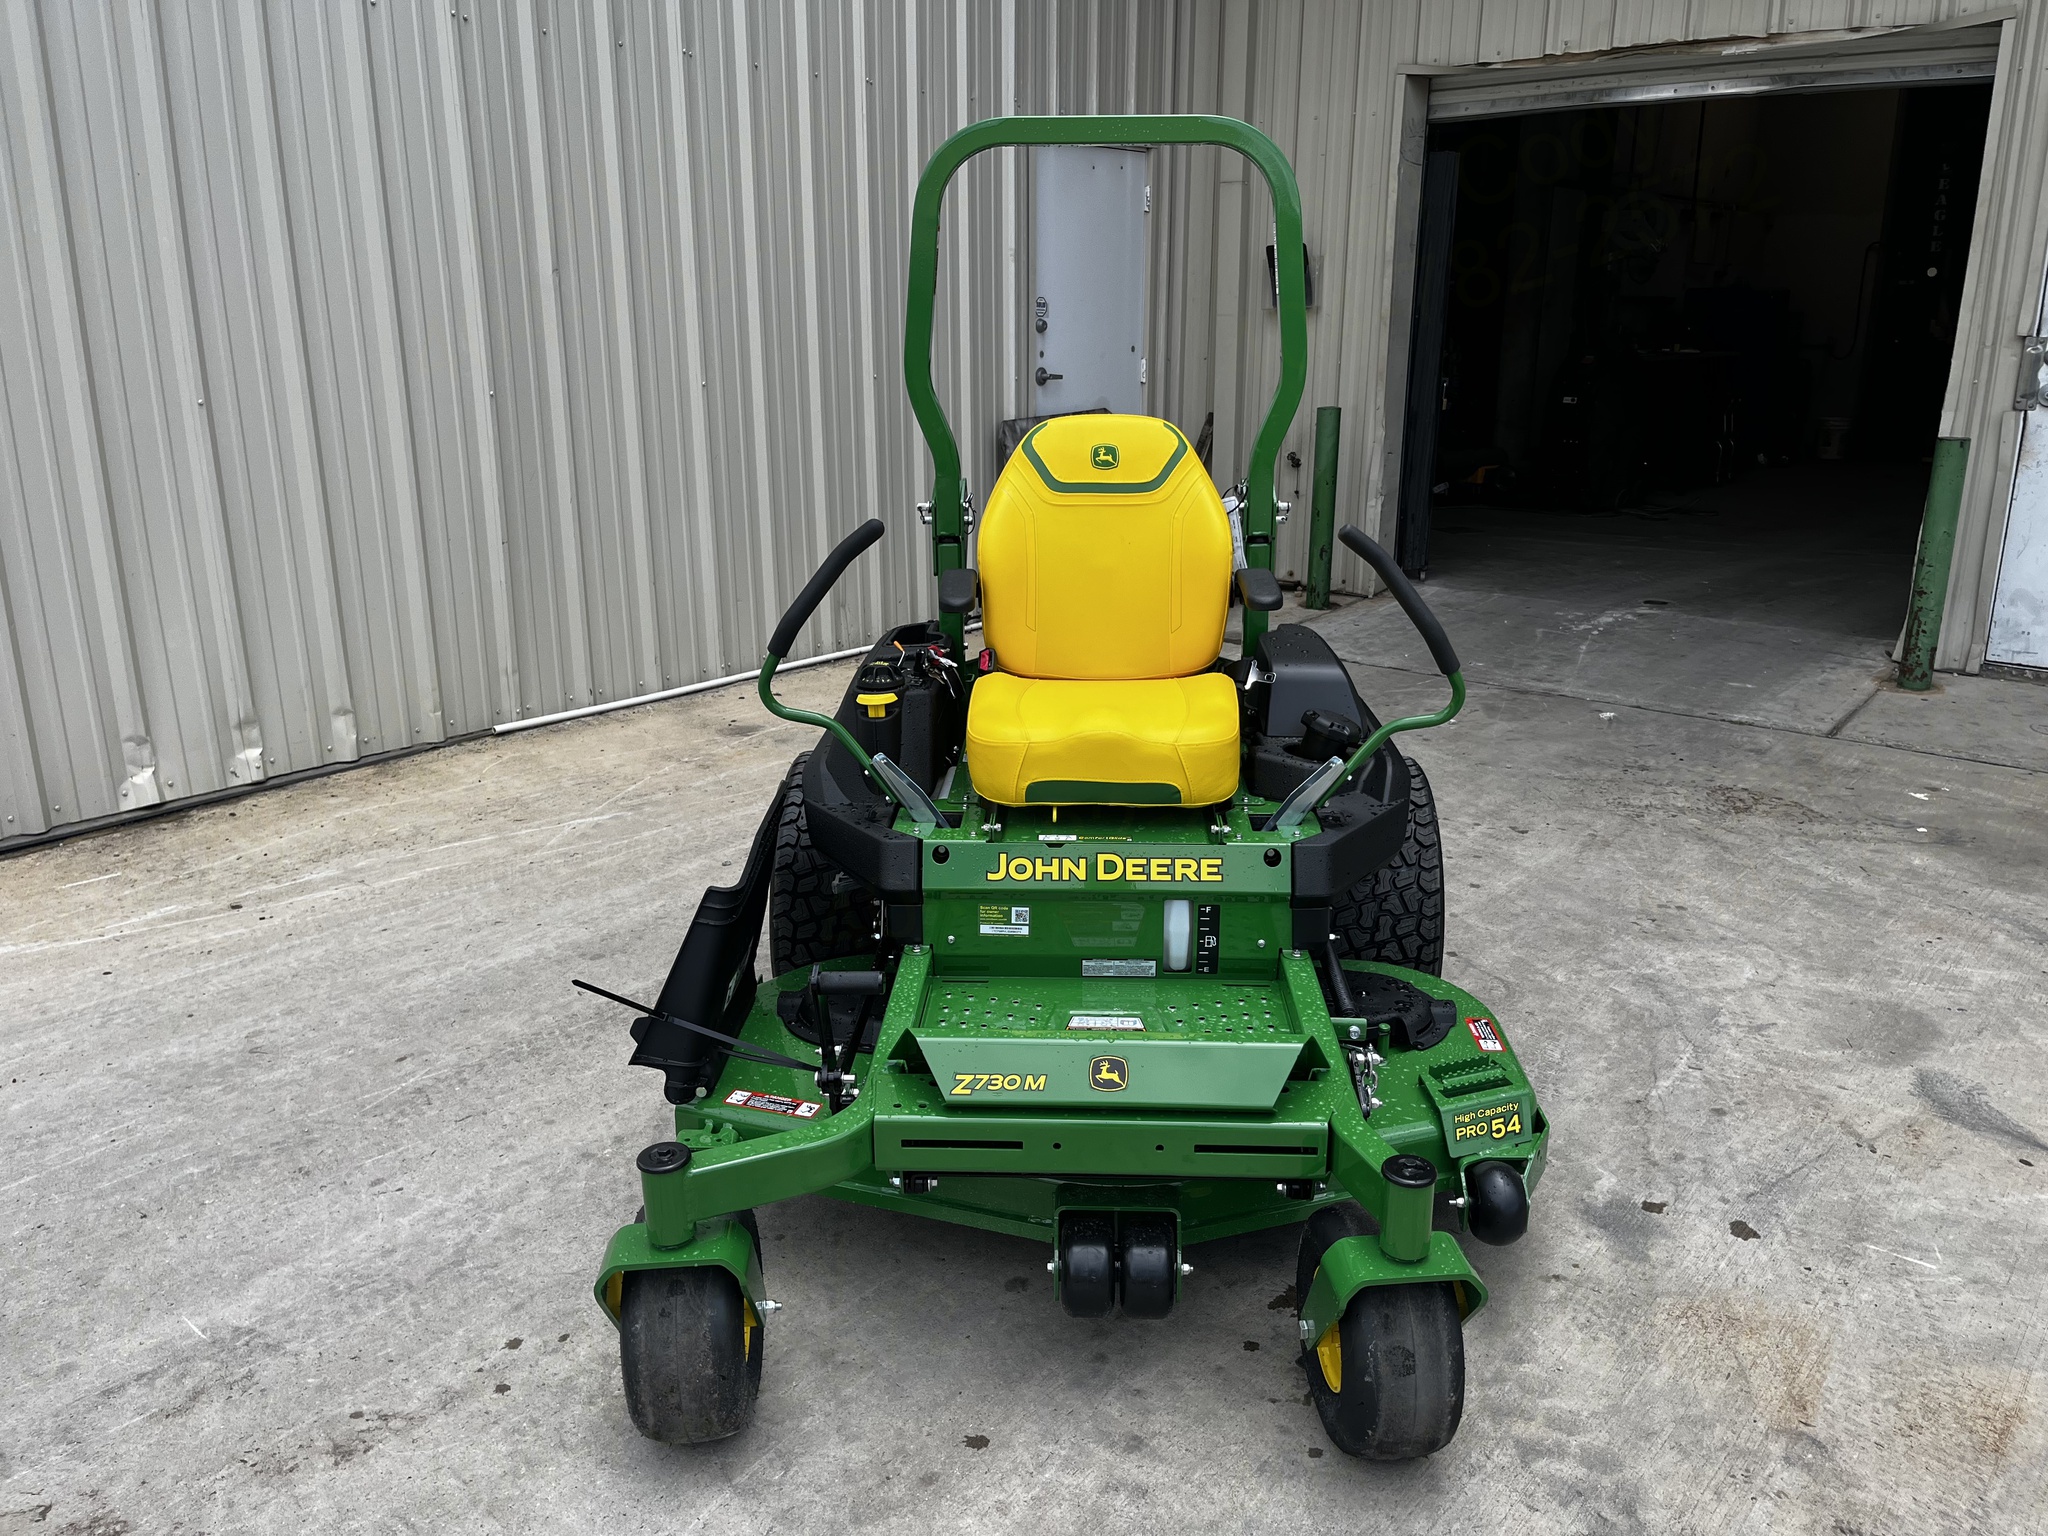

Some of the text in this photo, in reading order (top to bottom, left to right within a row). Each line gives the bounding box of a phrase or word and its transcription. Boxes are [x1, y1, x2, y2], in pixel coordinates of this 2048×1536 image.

[986, 852, 1224, 882] JOHN DEERE
[1205, 906, 1212, 914] F
[1454, 1102, 1519, 1124] High Capacity
[1455, 1113, 1522, 1142] PRO 54
